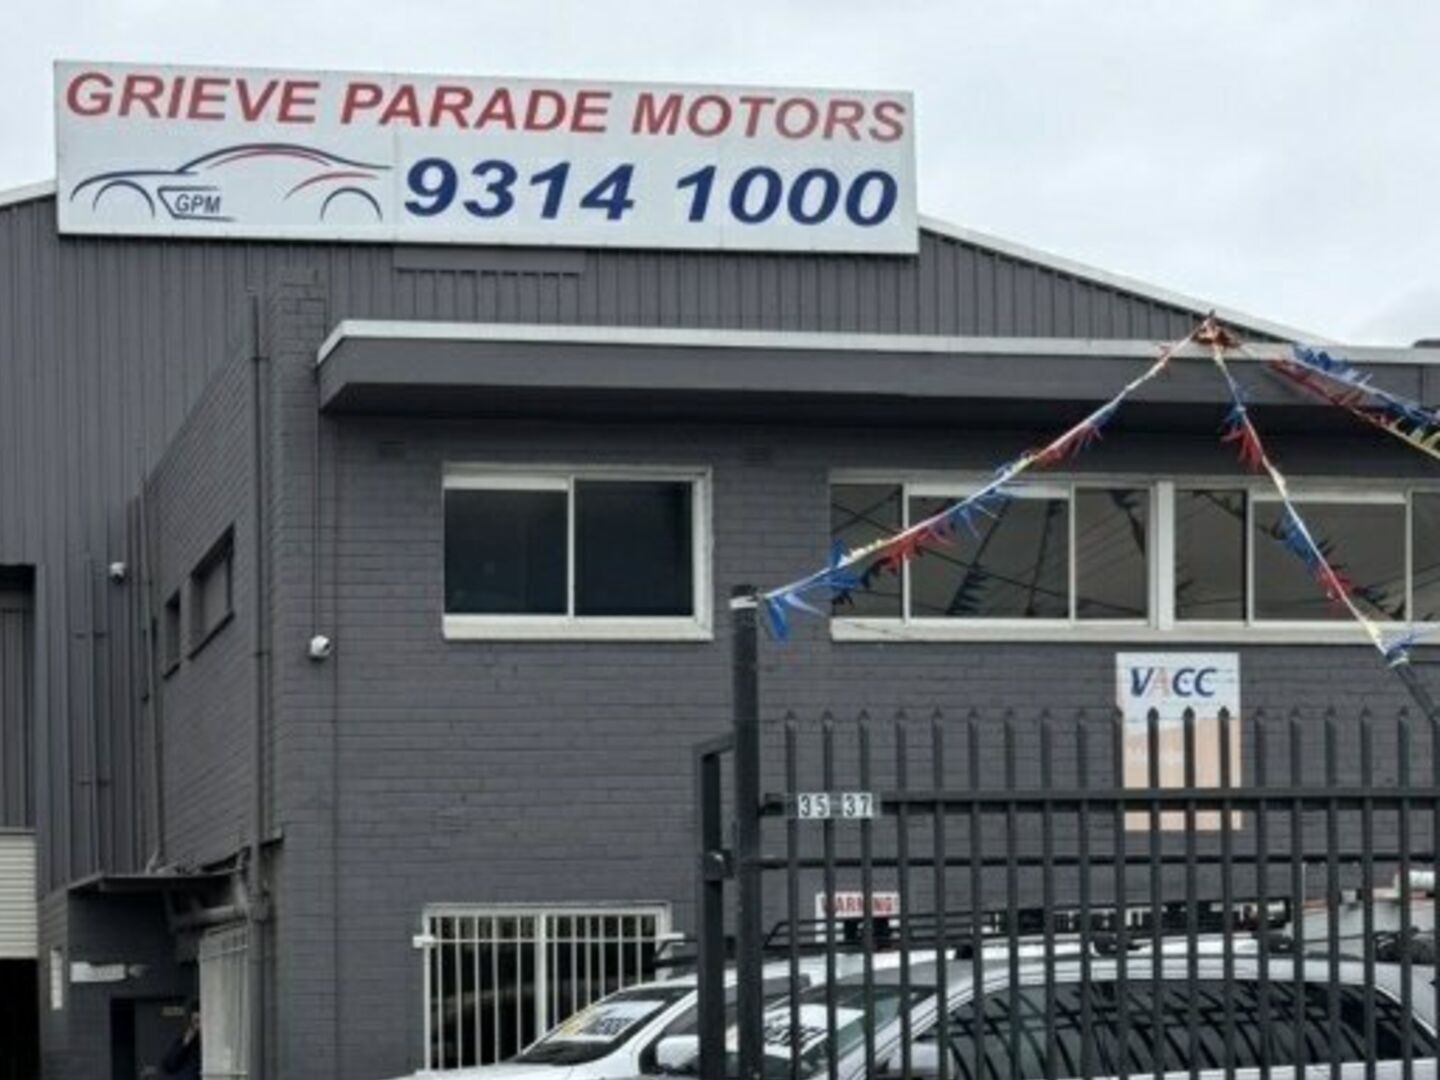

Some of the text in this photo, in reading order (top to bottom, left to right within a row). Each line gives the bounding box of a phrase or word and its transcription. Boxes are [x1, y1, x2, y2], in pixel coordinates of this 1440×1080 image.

[65, 71, 906, 143] GRIEVE PARADE MOTORS
[175, 193, 221, 213] GPM
[403, 157, 898, 227] 9314 1000
[1131, 666, 1217, 697] VACC
[800, 794, 871, 817] 35 37
